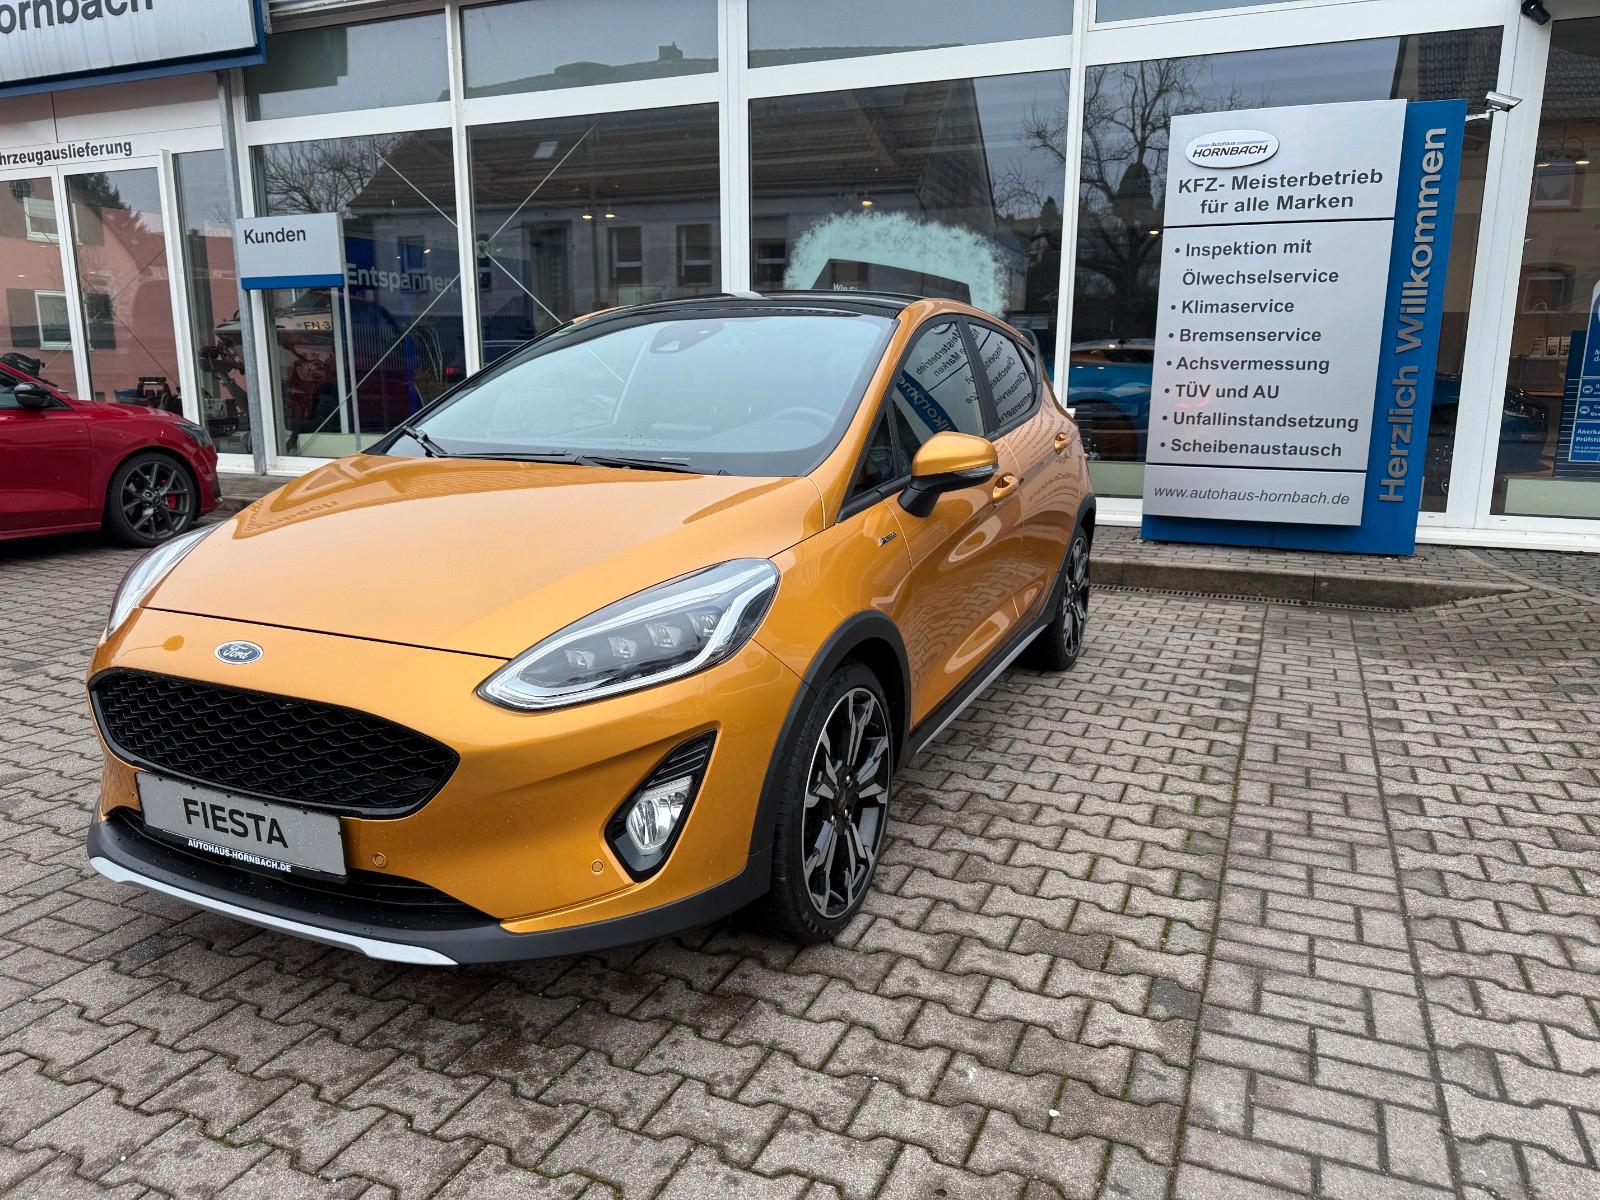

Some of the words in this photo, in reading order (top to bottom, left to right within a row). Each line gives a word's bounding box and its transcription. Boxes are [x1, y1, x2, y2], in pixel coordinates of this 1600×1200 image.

[1192, 145, 1269, 158] HORNBACH
[1178, 176, 1225, 195] KFZ-
[1232, 169, 1383, 191] Meisterbetrieb
[1200, 197, 1229, 215] für
[1234, 196, 1270, 213] alle
[1276, 193, 1355, 210] Marken
[243, 226, 307, 245] Kunden
[1396, 127, 1448, 353] Willkommen
[1185, 240, 1278, 258] Inspektion
[1283, 239, 1312, 254] mit
[1182, 268, 1339, 286] Ölwechselservice
[1181, 298, 1295, 314] Klimaservice
[1179, 327, 1322, 343] Bremsenservice
[1176, 355, 1330, 375] Achsvermessung
[1175, 381, 1211, 400] TÜV
[1215, 383, 1249, 399] und
[1253, 385, 1280, 400] AU
[1173, 411, 1359, 433] Unfallinstandsetzung
[1379, 365, 1419, 503] Herzlich
[1170, 438, 1342, 458] Scheibenaustausch
[1153, 486, 1350, 506] www.autohaus-hornbach.de
[221, 643, 254, 661] Ford
[183, 798, 289, 849] FIESTA
[187, 838, 292, 873] AUTOHAUS-HORNBACH.DE
